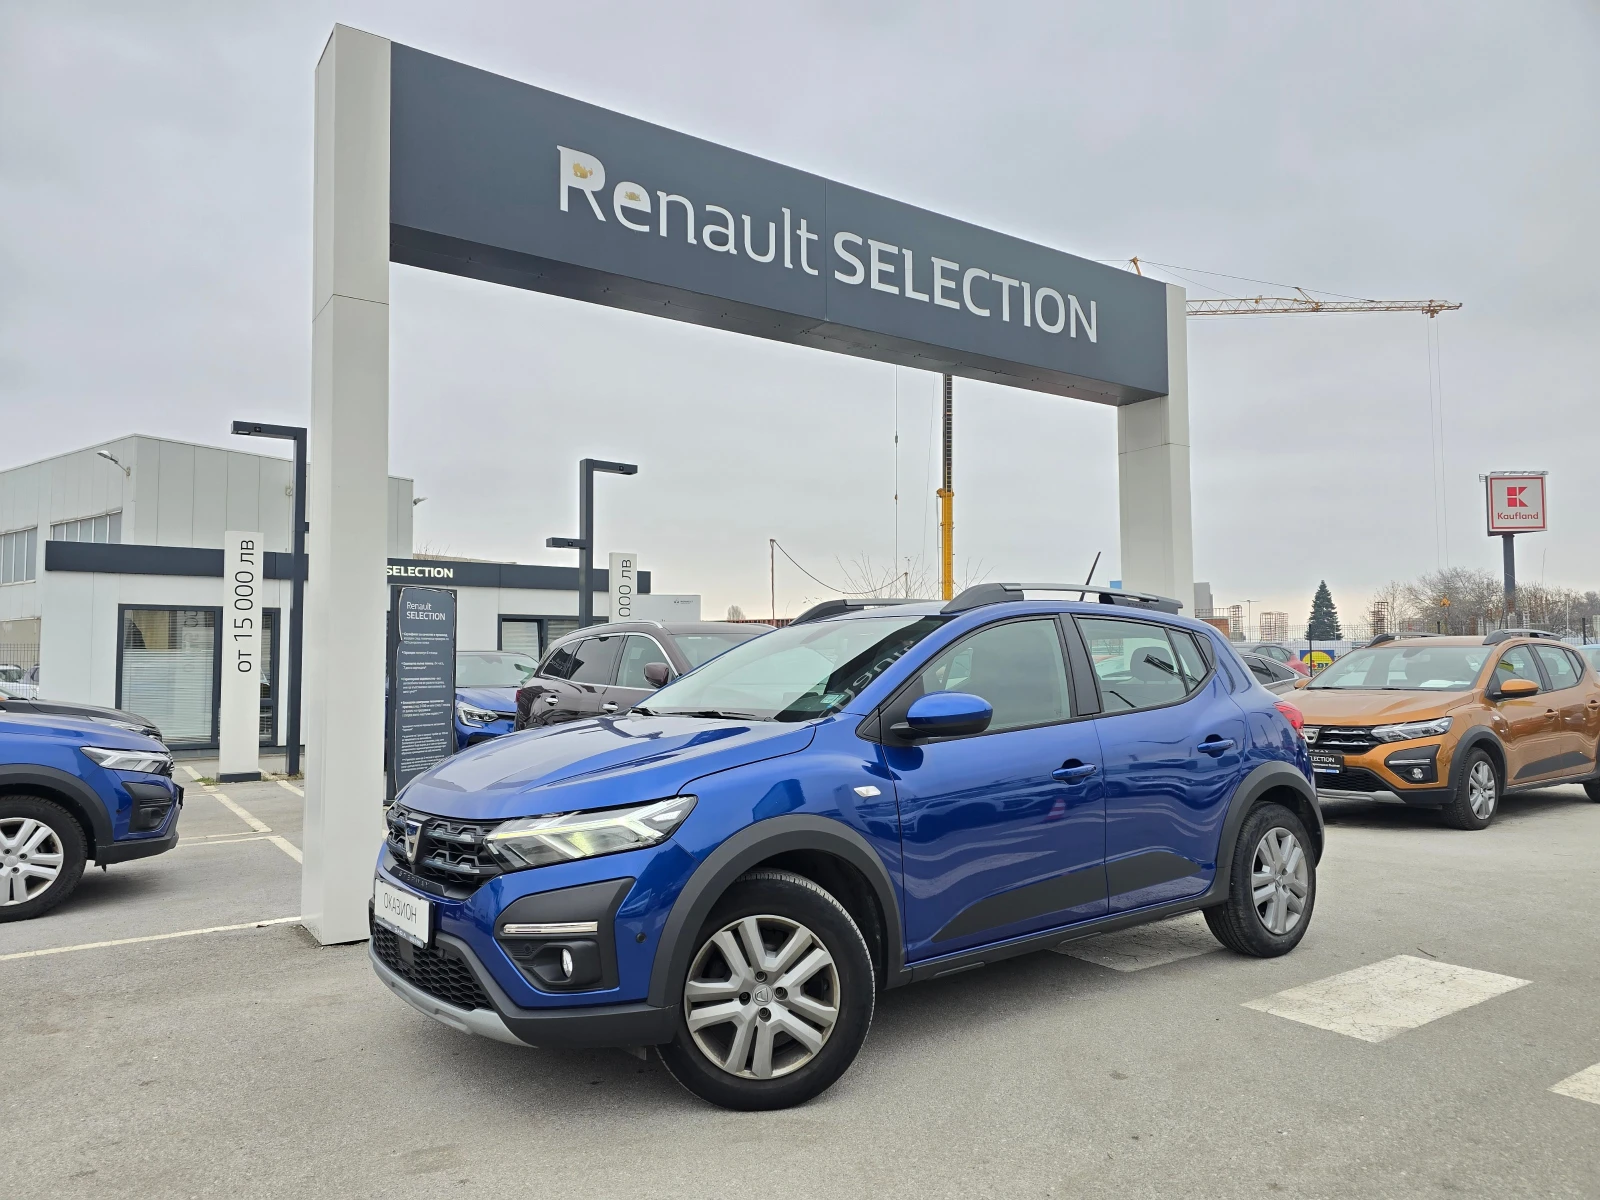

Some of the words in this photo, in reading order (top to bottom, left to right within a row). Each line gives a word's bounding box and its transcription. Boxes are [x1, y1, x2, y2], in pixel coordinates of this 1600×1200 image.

[557, 145, 819, 276] Renault
[833, 231, 1098, 344] SELECTION
[1497, 511, 1539, 520] Kaufland
[386, 565, 454, 578] SELECTION
[234, 571, 254, 611] 000
[618, 585, 632, 617] 000
[406, 601, 432, 611] Renault
[406, 611, 446, 620] SELECTION
[233, 617, 253, 642] 15
[383, 892, 417, 924] ОКАЗИОН
